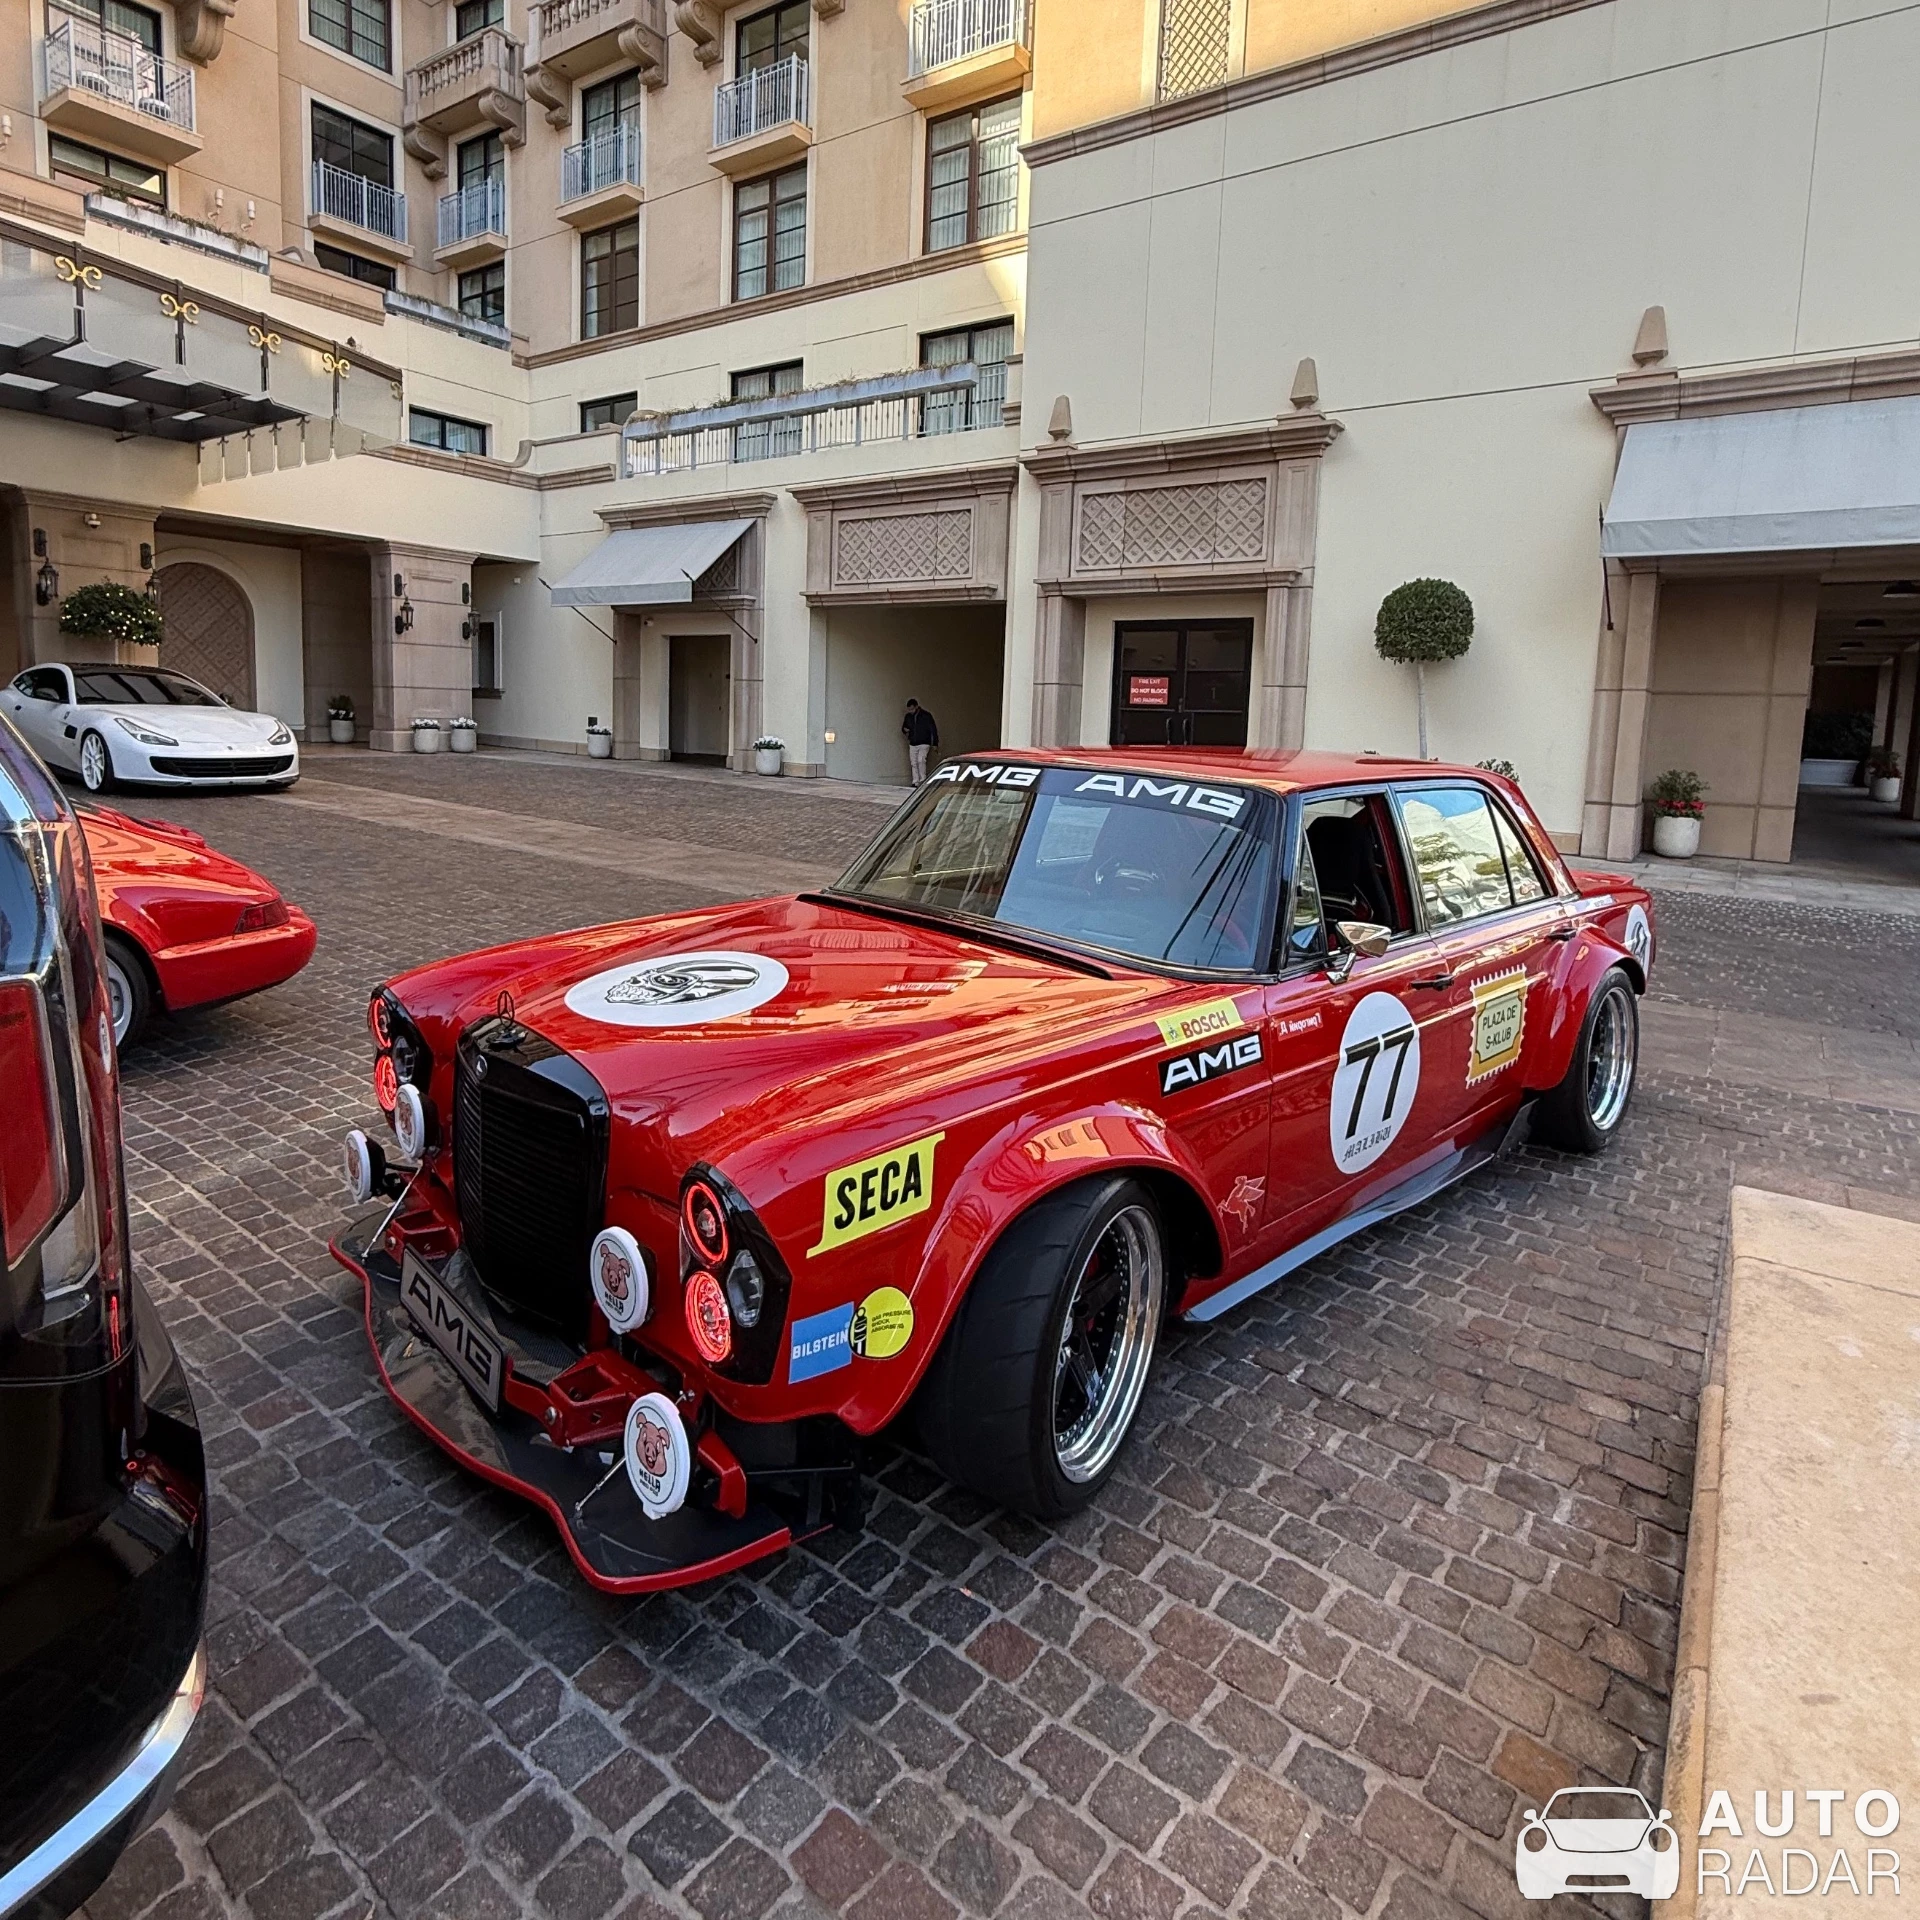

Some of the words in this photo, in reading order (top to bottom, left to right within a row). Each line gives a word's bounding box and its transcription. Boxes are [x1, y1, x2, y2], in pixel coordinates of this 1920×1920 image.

[926, 765, 1041, 787] AMG
[1074, 774, 1245, 819] AMG
[1180, 1010, 1230, 1039] BOSCH
[1482, 1009, 1506, 1030] PLAZA
[1485, 1026, 1512, 1049] S-KLUB
[1163, 1034, 1262, 1092] AMG
[1344, 1022, 1414, 1140] 77
[1342, 1125, 1392, 1163] MALIBU
[834, 1152, 922, 1230] SECA
[604, 1291, 624, 1313] HELLA
[882, 1309, 911, 1317] PRESSURE
[408, 1271, 492, 1385] AMG
[871, 1318, 889, 1327] SHOCK
[792, 1329, 849, 1360] BILSTEIN
[639, 1468, 661, 1493] HELLA
